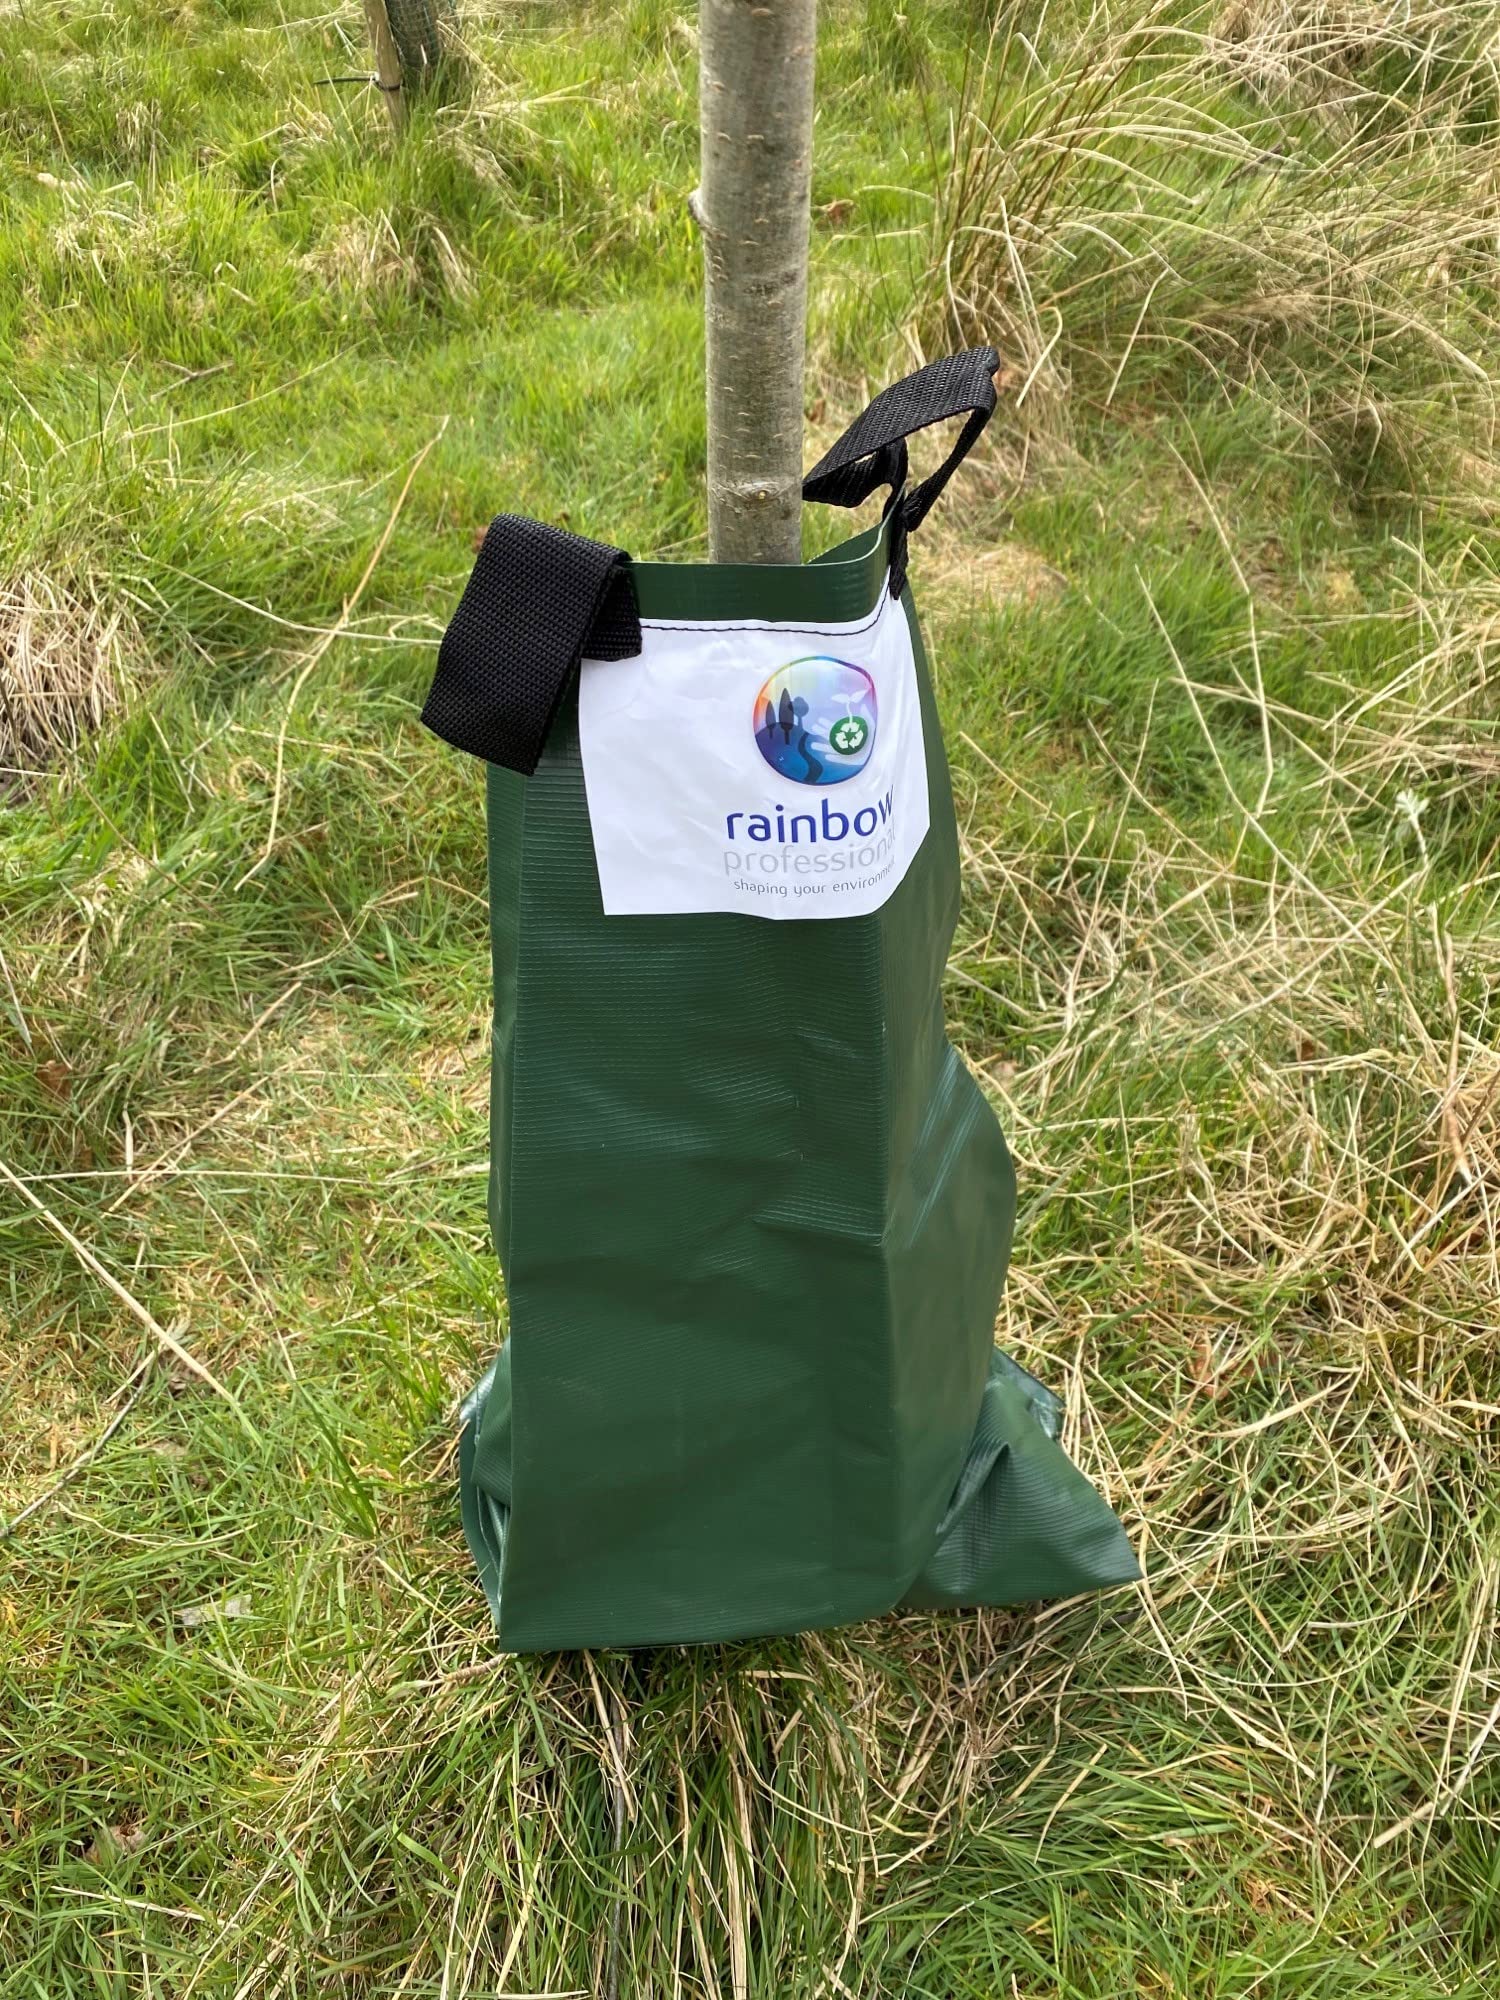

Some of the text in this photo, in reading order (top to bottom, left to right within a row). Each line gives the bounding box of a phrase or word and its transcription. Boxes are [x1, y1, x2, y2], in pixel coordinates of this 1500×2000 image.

[726, 784, 894, 843] rainbow
[723, 815, 896, 876] professional
[733, 878, 788, 898] shaping
[793, 884, 827, 898] your
